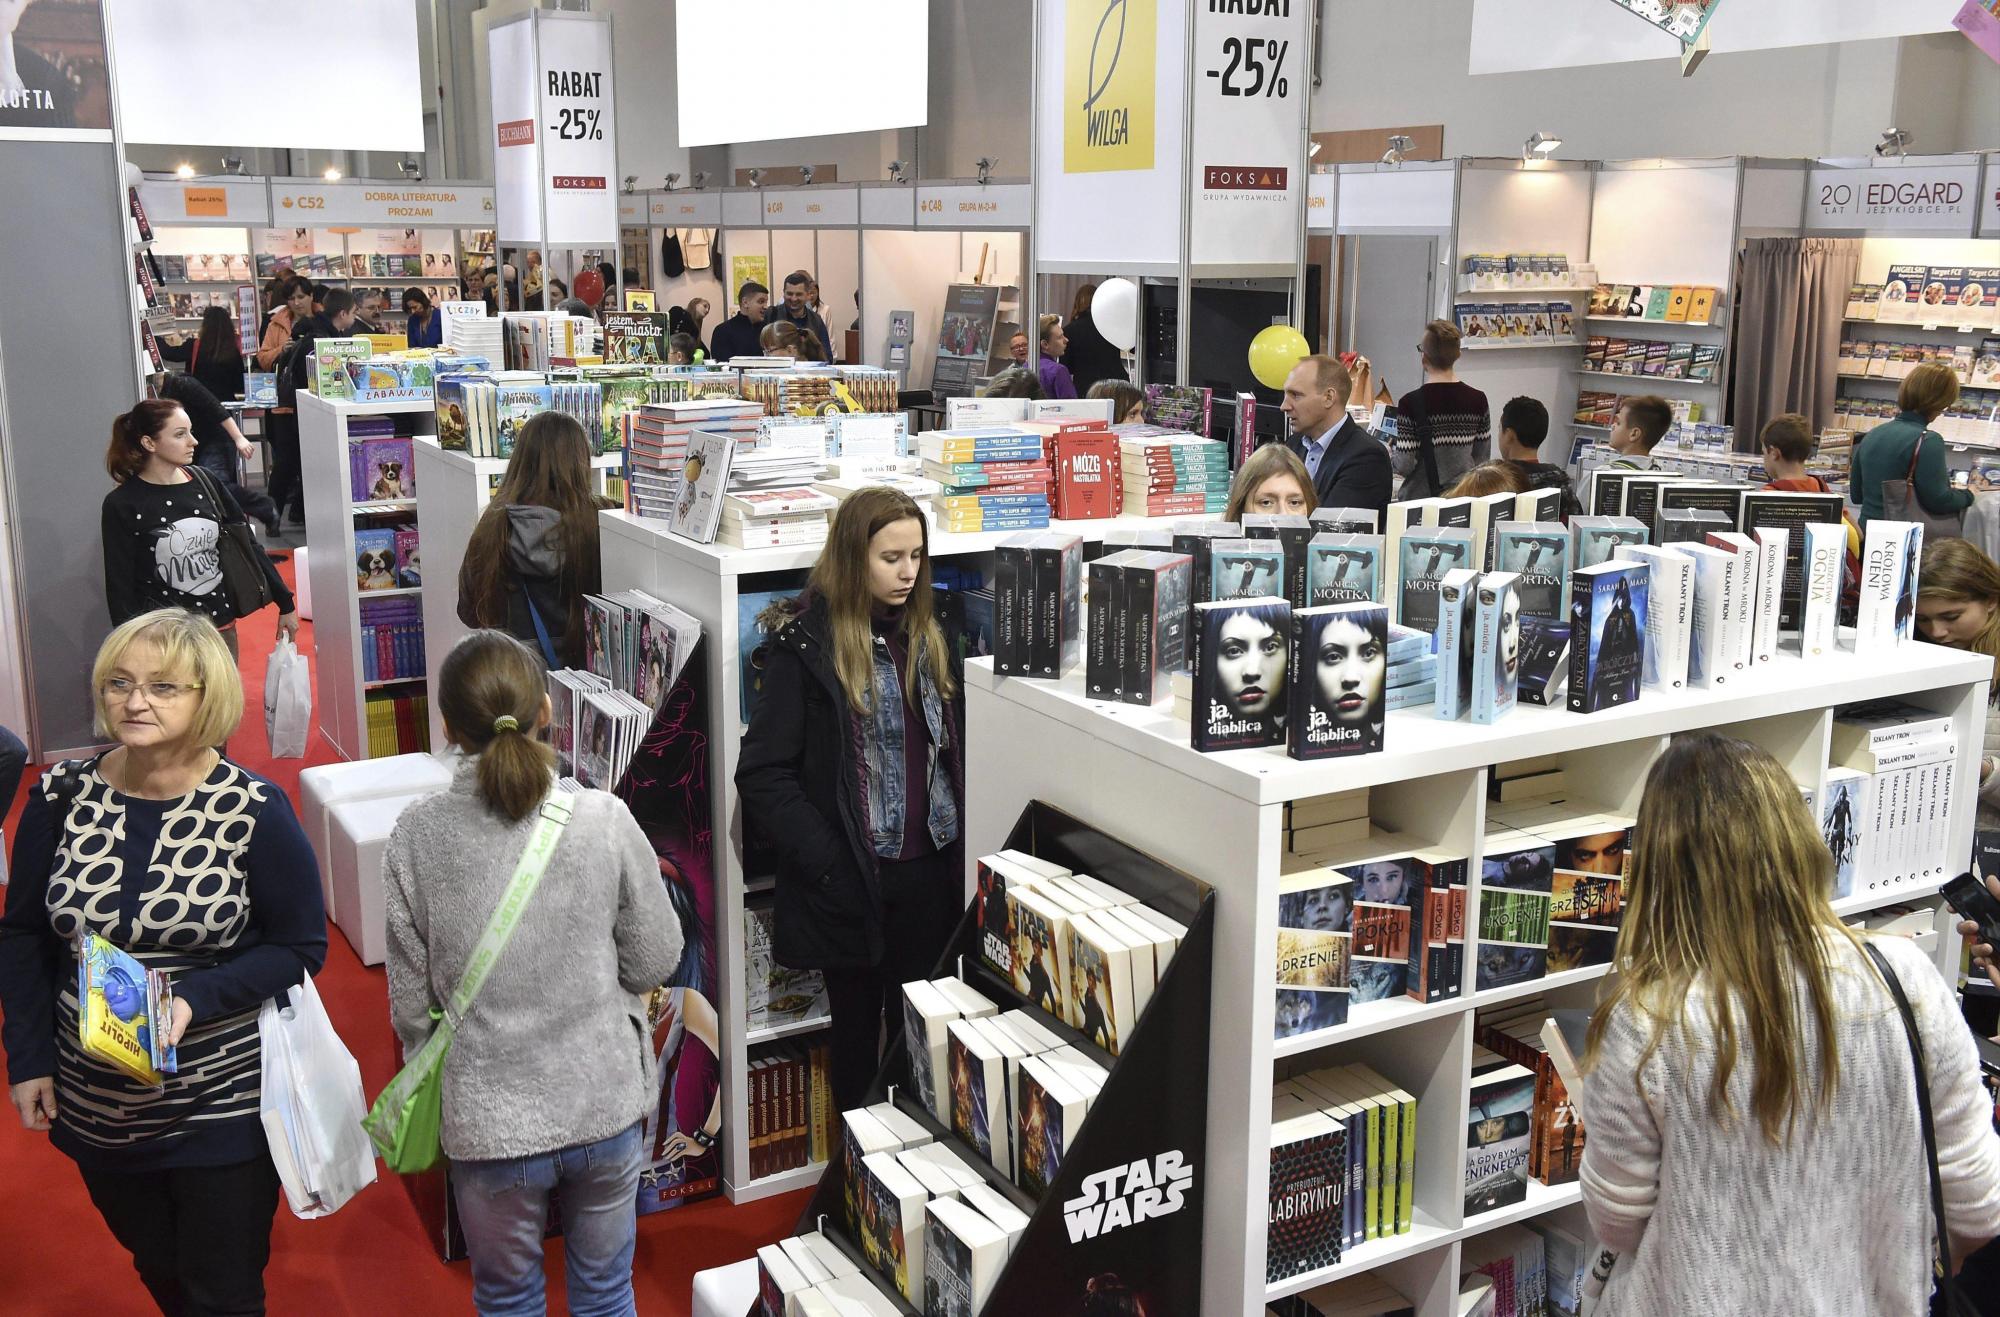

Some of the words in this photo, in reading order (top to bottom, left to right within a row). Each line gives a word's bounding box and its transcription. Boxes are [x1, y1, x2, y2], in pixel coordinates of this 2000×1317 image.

[1206, 36, 1289, 99] -25%
[547, 70, 602, 98] RABAT
[499, 125, 532, 142] BUCHMANN
[549, 107, 603, 141] -25%
[1087, 107, 1128, 147] WILGA
[297, 197, 325, 209] C52
[365, 192, 400, 201] DOBRA
[402, 193, 457, 202] LITERATURA
[1233, 194, 1287, 202] WYDAWNICZA
[1820, 184, 1851, 206] 20
[1866, 182, 1963, 205] EDGARD
[388, 207, 433, 217] PROZAMI
[928, 200, 942, 211] C48
[1825, 206, 1845, 214] LAT
[1891, 265, 1926, 274] ANGIELSKI
[323, 346, 343, 354] MOJE
[345, 345, 365, 353] CIAŁO
[365, 389, 415, 401] ZABAWA
[421, 389, 432, 397] W
[886, 464, 897, 472] TED
[1072, 451, 1101, 473] MÓZG
[1073, 473, 1102, 483] NASTOLATKA
[1742, 550, 1754, 585] KORONA
[1766, 543, 1777, 578] KORONA
[1867, 549, 1883, 589] CIENI
[1879, 540, 1897, 601] KRÓLOWA
[1324, 580, 1360, 588] MARCIN
[1598, 581, 1620, 593] SARAH
[1629, 577, 1648, 587] MAAS
[1680, 564, 1690, 600] SZKLANY
[1723, 561, 1734, 597] SZKLANY
[1811, 548, 1829, 601] OGNIA
[1825, 547, 1838, 604] DZIEDZICTWO
[1231, 587, 1266, 596] MARCIN
[1313, 588, 1370, 600] MORTKA
[1406, 580, 1441, 591] MORT
[1573, 585, 1592, 593] MAAS
[1722, 597, 1730, 621] TRON
[1739, 593, 1748, 624] MROKU
[1763, 586, 1773, 616] MROKU
[1678, 600, 1686, 624] TRON
[1207, 720, 1263, 736] diablica
[1306, 727, 1361, 743] diablica
[1873, 734, 1895, 744] SZKLANY
[1896, 732, 1911, 740] TRON
[1878, 756, 1901, 766] SZKLANY
[1901, 753, 1916, 762] TRON
[1550, 892, 1618, 913] GRZESZNIK
[1484, 907, 1541, 929] UKOJENIE
[984, 932, 1010, 956] STAR
[983, 943, 1013, 972] WARS
[99, 1021, 141, 1058] HIPOLIT
[1477, 1147, 1519, 1166] GDYBYM
[1064, 1150, 1193, 1213] STAR
[1286, 1175, 1326, 1193] PRZEBUDZENIE
[1064, 1177, 1193, 1244] WARS
[1268, 1183, 1342, 1224] LABIRYNTU
